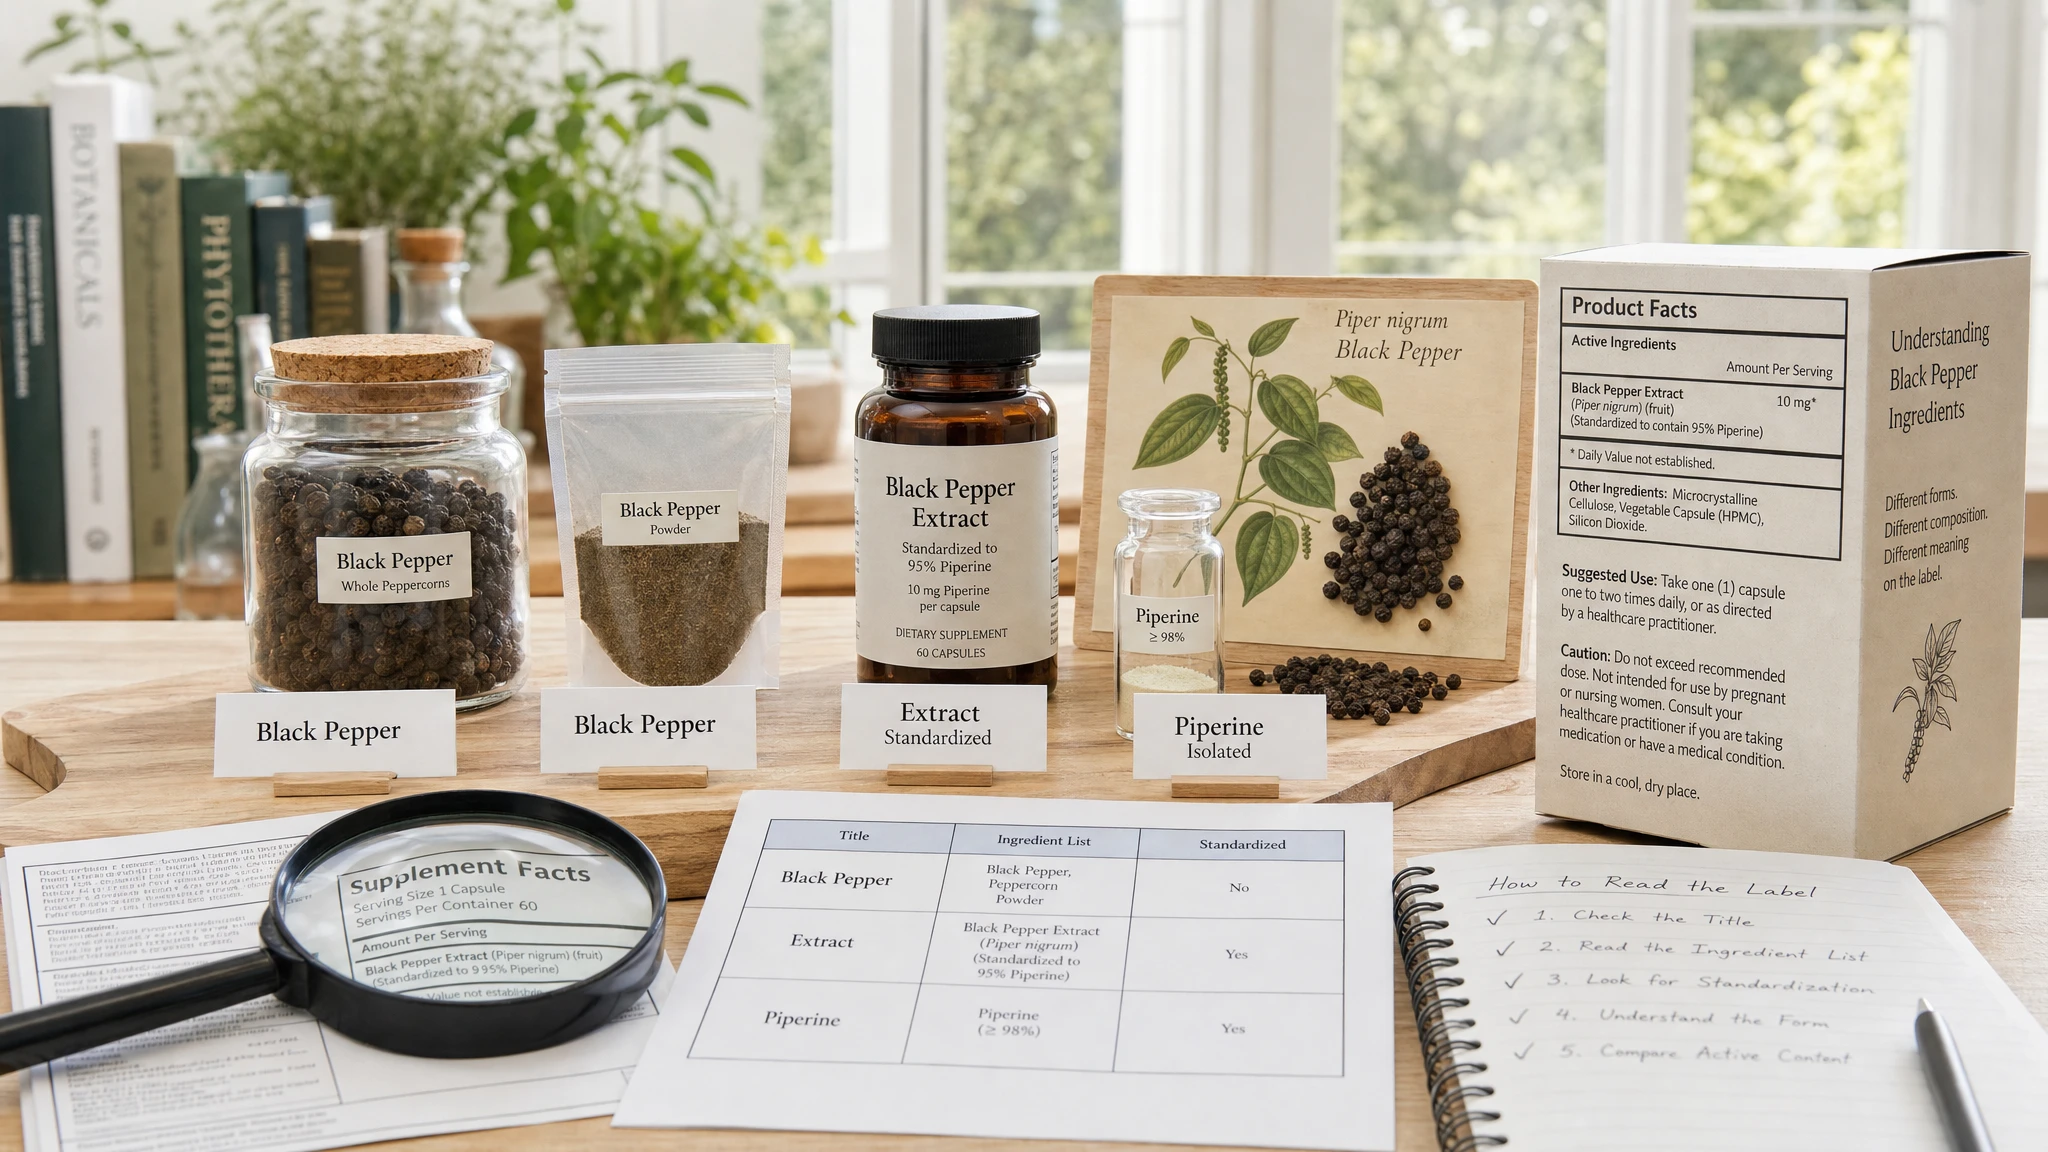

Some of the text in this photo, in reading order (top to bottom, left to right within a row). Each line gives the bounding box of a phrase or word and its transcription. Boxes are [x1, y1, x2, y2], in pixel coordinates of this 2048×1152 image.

[69, 123, 103, 330] BOTANICALS
[1572, 296, 1698, 319] Product Facts
[1334, 309, 1448, 336] Piper nigrum
[1571, 334, 1677, 352] Active Ingredients
[1891, 320, 1990, 353] Understanding
[1334, 338, 1463, 368] Black Pepper
[1726, 360, 1834, 382] Amount Per Serving
[1889, 362, 1979, 392] Black Pepper
[1571, 381, 1684, 400] Black Pepper Extract
[1570, 397, 1675, 418] (Piper nigrum) (fruit)
[1777, 395, 1791, 408] 10
[1888, 400, 1965, 434] Ingredients
[1577, 448, 1716, 470] Daily Value not established.
[886, 475, 1016, 506] Black Pepper
[1568, 479, 1758, 507] Other Ingredients: Microcrystalline
[1885, 486, 1958, 512] Different forms.
[620, 501, 721, 521] Black Pepper
[912, 506, 990, 528] Extract
[650, 522, 692, 536] Powder
[902, 541, 998, 556] Standardized to
[336, 551, 454, 574] Black Pepper
[907, 559, 992, 577] 95% Piperine
[340, 579, 450, 594] Whole Peppercorns
[908, 583, 990, 600] 10 mg Piperine
[1562, 563, 1786, 601] Suggested Use: Take one (1) capsule
[919, 600, 981, 615] per capsule
[1136, 607, 1200, 629] Piperine
[895, 626, 1008, 641] DIETARY SUPPLEMENT
[1160, 631, 1186, 643] 98%
[916, 647, 986, 659] 60 CAPSULES
[900, 702, 980, 723] Extract
[256, 720, 402, 747] Black Pepper
[574, 713, 716, 740] Black Pepper
[1174, 716, 1264, 743] Piperine
[884, 728, 992, 746] Standardized
[1187, 742, 1252, 759] Isolated
[839, 830, 870, 841] Title
[997, 834, 1092, 848] Ingredient List
[1199, 839, 1286, 850] Standardized
[350, 859, 591, 895] Supplement Facts
[781, 870, 893, 890] Black Pepper
[986, 864, 1072, 880] Black Pepper,
[988, 878, 1058, 893] Peppercorn
[1230, 882, 1250, 893] No
[1488, 875, 1817, 898] How to Read the Label
[353, 883, 505, 913] Serving Size 1 Capsule
[996, 894, 1044, 905] Powder
[356, 898, 538, 928] Servings Per Container 60
[1534, 909, 1755, 927] 1. Check the Title
[963, 922, 1100, 938] Black Pepper Extract
[361, 927, 487, 954] Amount Per Serving
[790, 933, 854, 948] Extract
[979, 937, 1079, 953] (Piper nigrum)
[972, 952, 1081, 966] (Standardized to
[1225, 948, 1248, 960] Yes
[1539, 940, 1866, 962] 2. Read the Ingredient List
[365, 950, 603, 976] Black Pepper Extract (Piper nigrum) (fruit)
[373, 966, 453, 988] (Standardized
[456, 967, 468, 975] to
[510, 964, 559, 975] Piperine)
[977, 968, 1070, 983] 95% Piperine)
[1547, 972, 1874, 994] 3. Look for Standardization
[764, 1010, 841, 1030] Piperine
[978, 1008, 1040, 1023] Piperine
[1555, 1008, 1830, 1029] 4. Understand the Form
[1002, 1024, 1041, 1038] 98%)
[1221, 1023, 1246, 1034] Yes
[1561, 1042, 1852, 1065] 5. Compare Active Content
